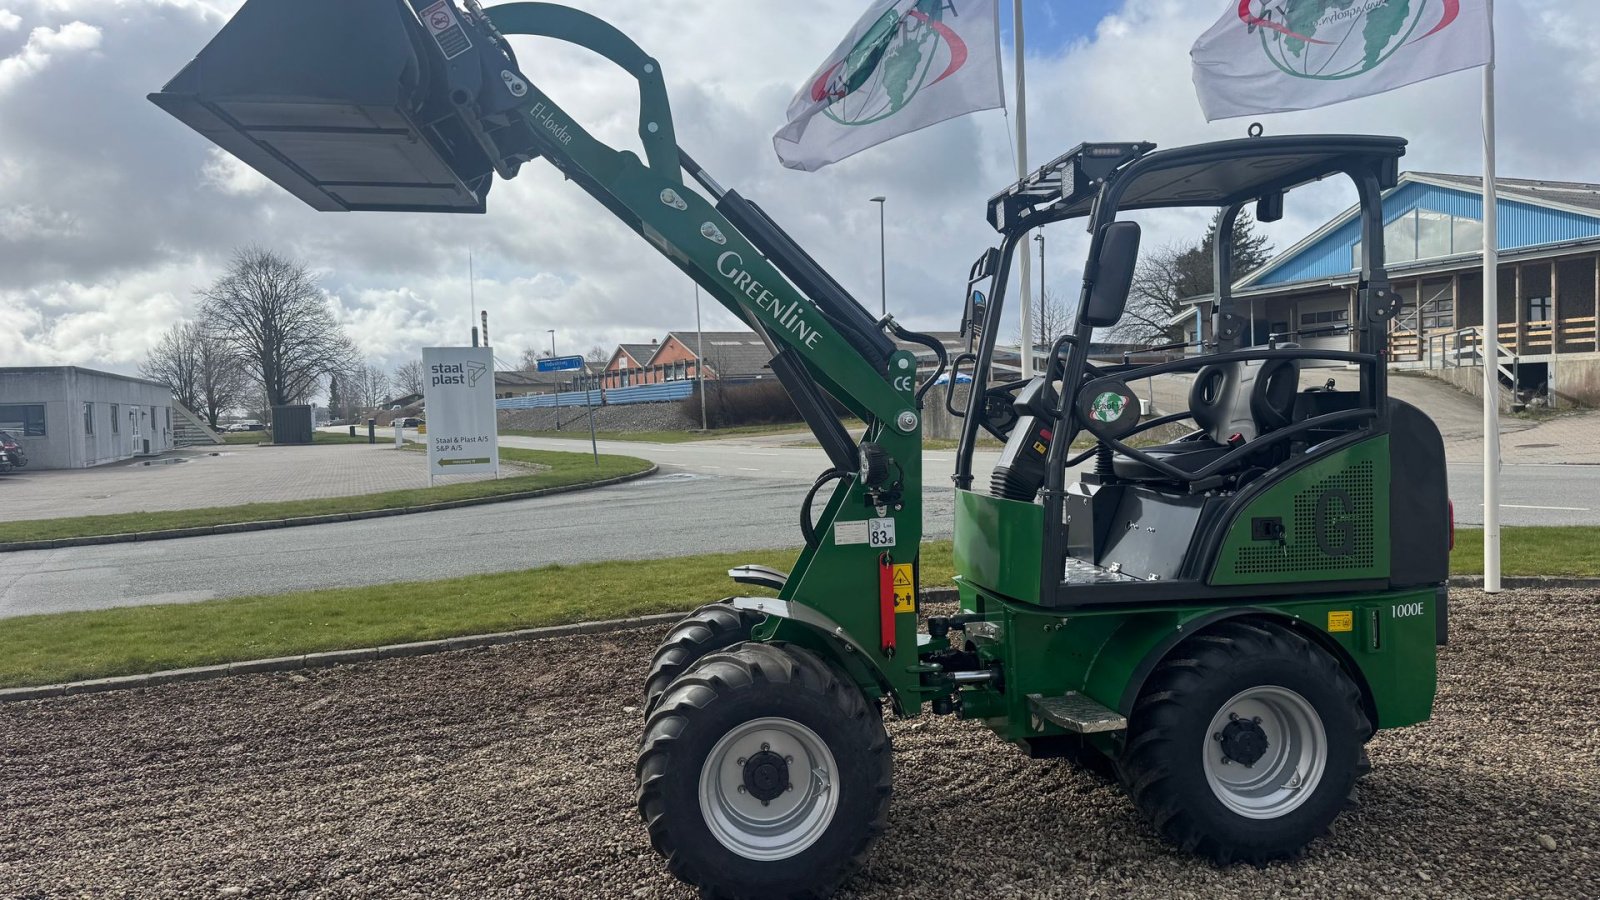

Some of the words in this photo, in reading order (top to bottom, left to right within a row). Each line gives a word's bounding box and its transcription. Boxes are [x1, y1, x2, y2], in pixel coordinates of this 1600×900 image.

[431, 363, 464, 374] staal
[432, 374, 465, 387] plast
[894, 376, 912, 391] CE
[872, 530, 887, 545] 83
[1391, 602, 1424, 618] 1000E
